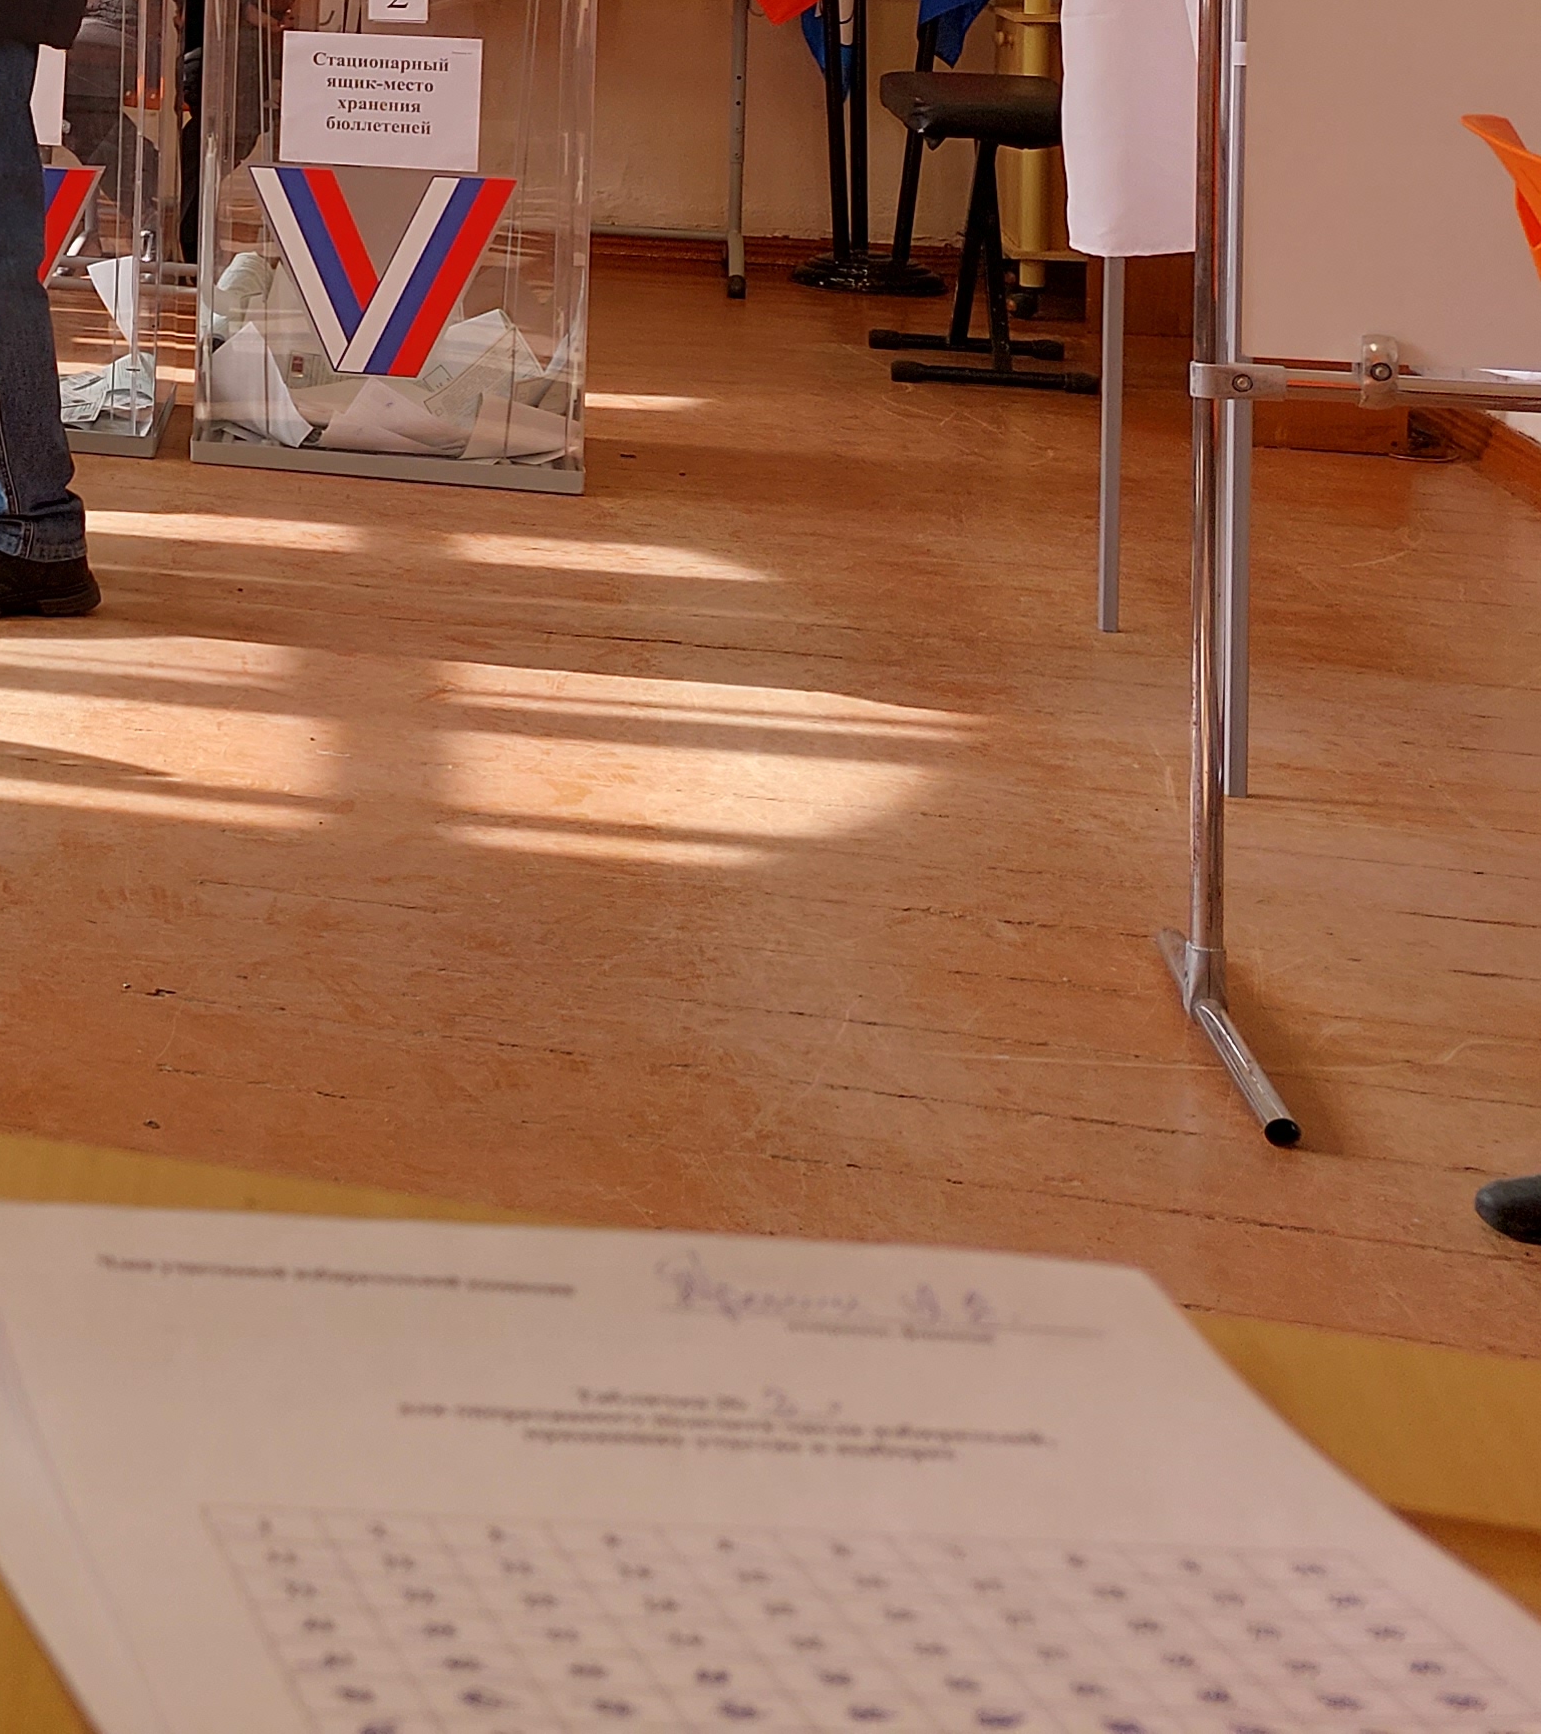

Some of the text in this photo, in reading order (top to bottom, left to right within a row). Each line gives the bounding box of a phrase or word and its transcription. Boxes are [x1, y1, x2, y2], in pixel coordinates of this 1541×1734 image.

[312, 51, 449, 73] Стационарный
[326, 77, 434, 93] ящик-место
[337, 96, 421, 113] хранения
[326, 115, 431, 135] бюллетеней
